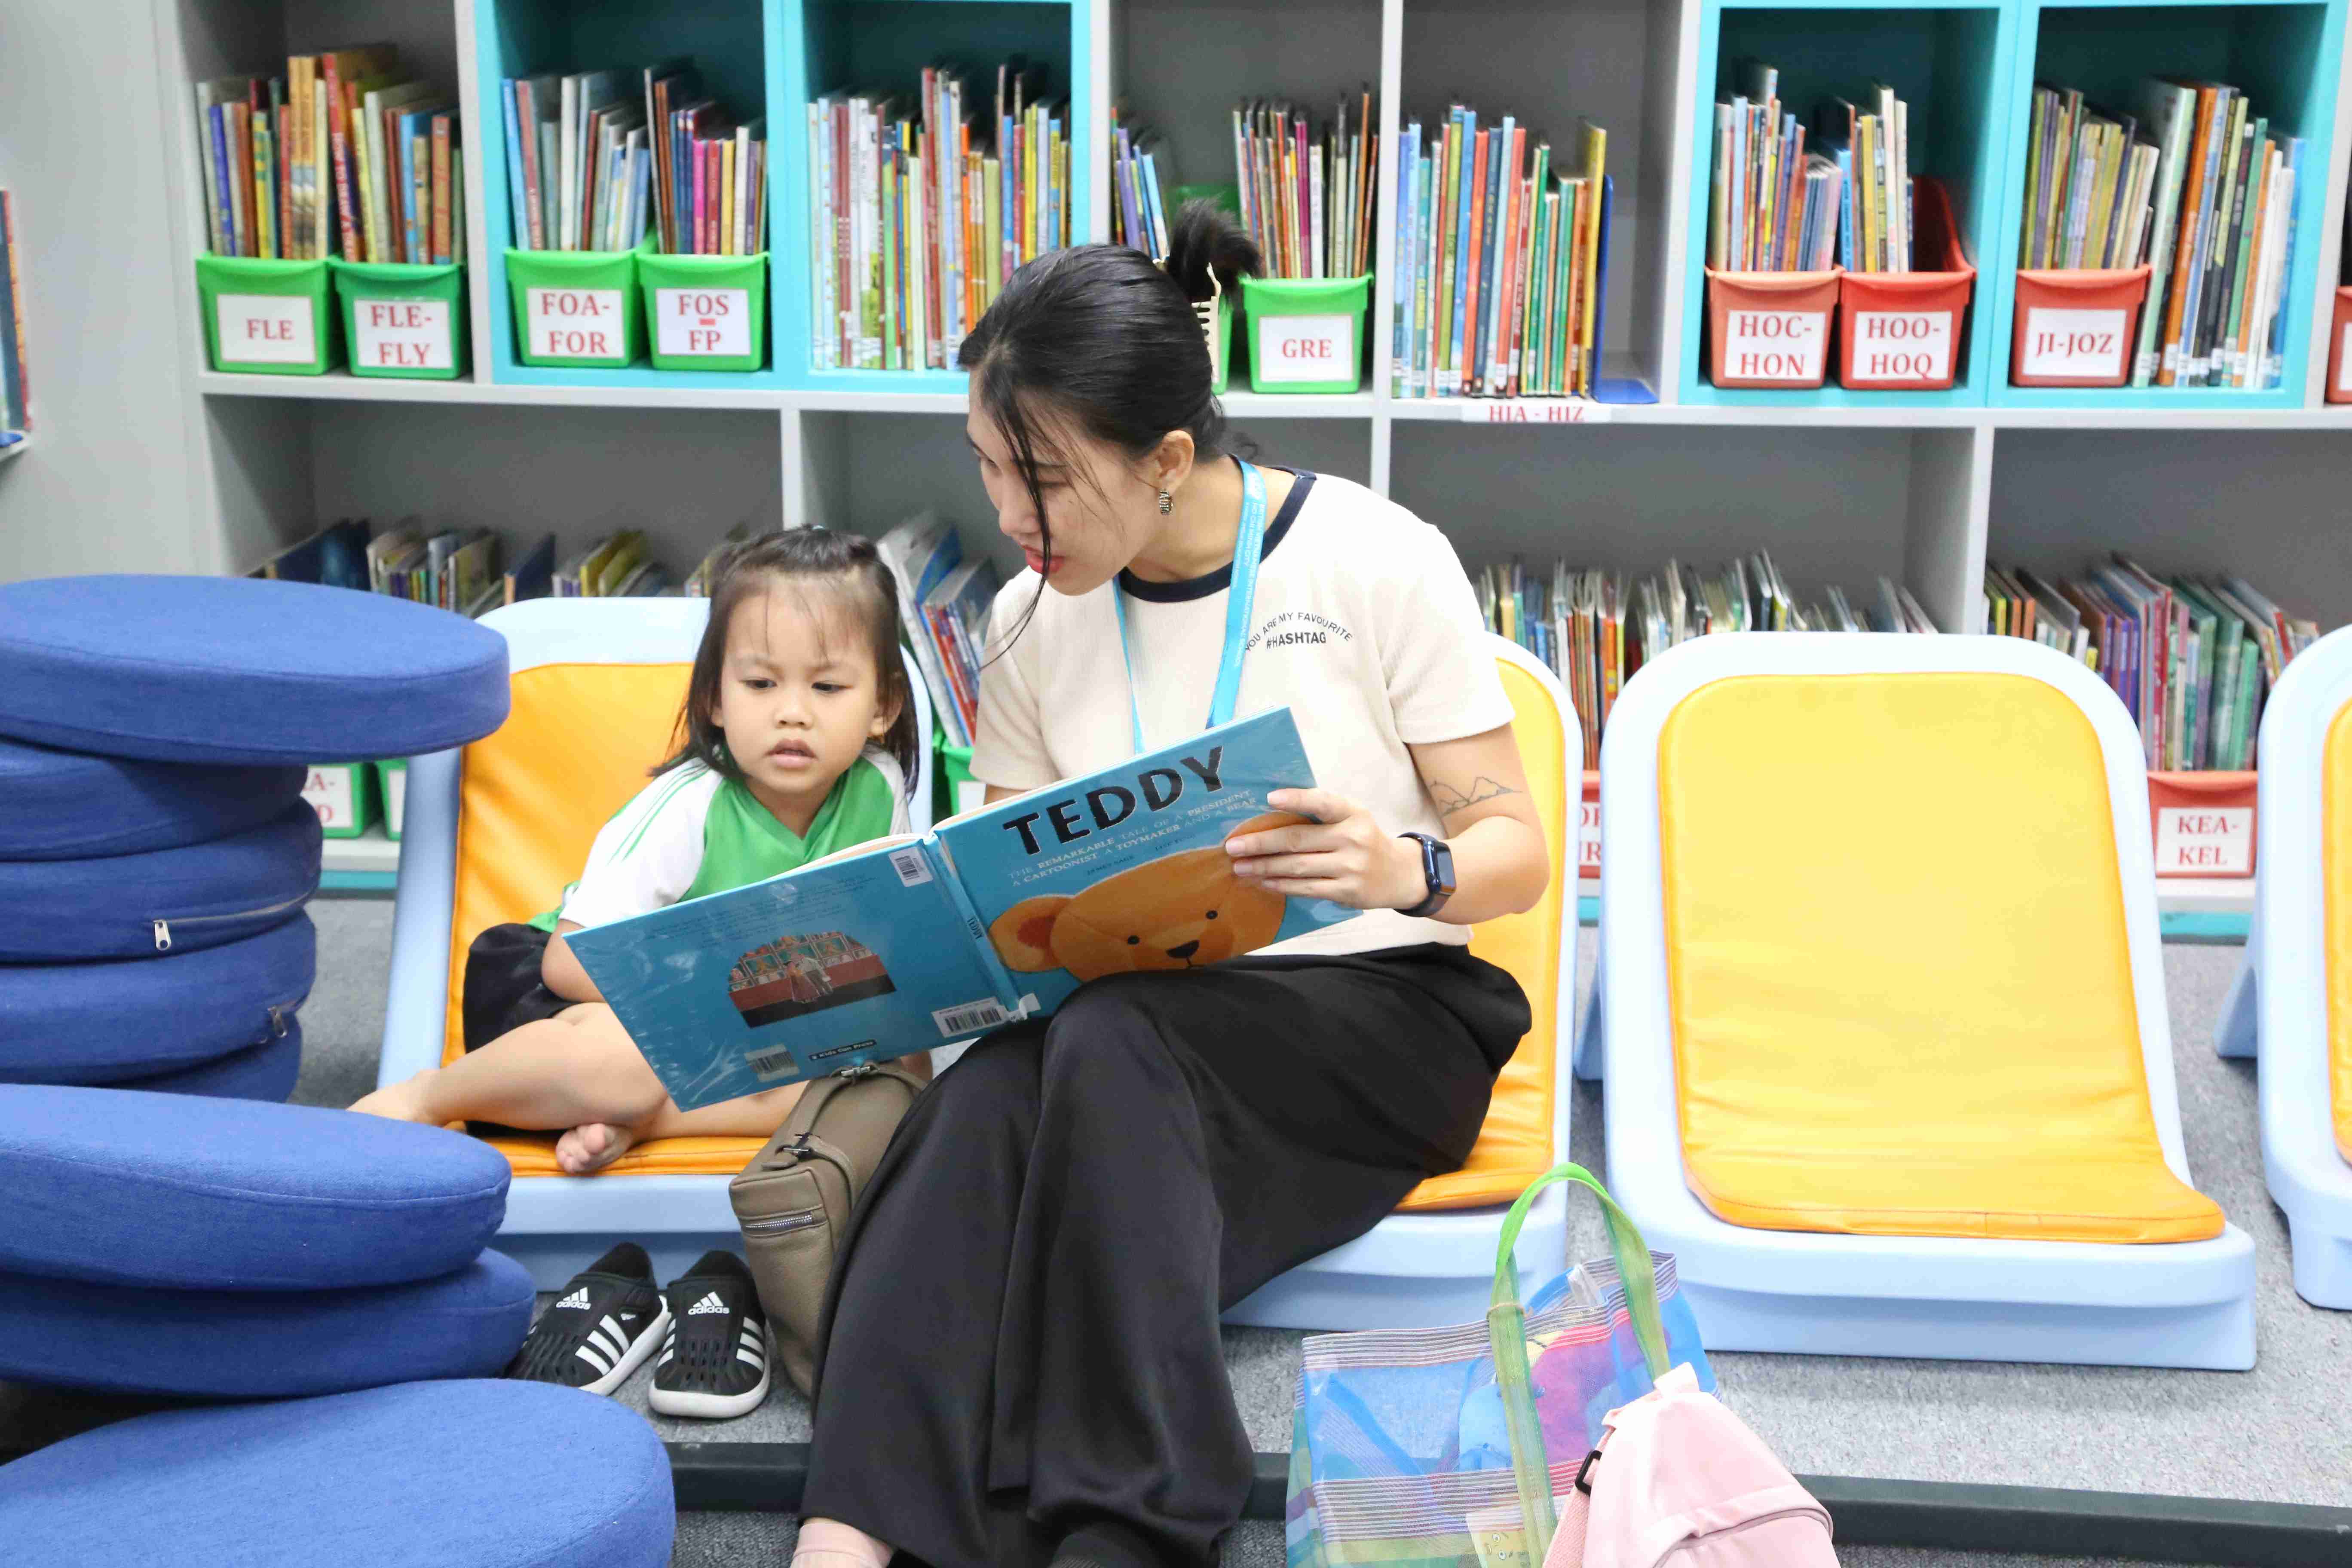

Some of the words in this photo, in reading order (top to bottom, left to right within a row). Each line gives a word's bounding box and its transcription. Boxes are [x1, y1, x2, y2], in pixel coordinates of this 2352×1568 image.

[543, 294, 610, 316] FOA-
[679, 296, 729, 315] FOS
[371, 306, 432, 327] FLE-
[1740, 315, 1811, 337] HOC-
[248, 320, 294, 340] FLE
[1868, 317, 1941, 340] HOO-
[550, 331, 606, 354] FOR
[689, 330, 720, 351] FP
[1282, 340, 1331, 358] GRE
[2037, 332, 2111, 358] JI-JOZ
[380, 344, 430, 365] FLY
[1741, 353, 1805, 376] HON
[1871, 354, 1932, 379] HOQ
[1490, 406, 1527, 421] HIA
[1548, 406, 1584, 420] HIZ
[1245, 635, 1261, 652] YOU
[1263, 619, 1277, 634] ARE
[1278, 612, 1293, 623] MY
[1298, 612, 1353, 641] FAVOURITE
[1266, 632, 1326, 649] #HASHTAG
[1002, 745, 1224, 855] TEDDY
[1104, 848, 1112, 856] A
[1117, 824, 1181, 851] TOYMAKER
[1184, 813, 1210, 827] AND
[1228, 798, 1257, 812] BEAR
[2178, 815, 2239, 833] KEA-
[1009, 867, 1032, 879] THE
[1038, 837, 1115, 870] REMARKABLE
[1121, 827, 1148, 840] TALE
[1154, 818, 1170, 829] OF
[1174, 813, 1182, 821] A
[2179, 846, 2227, 865] KEL
[966, 917, 983, 940] TEDDY
[556, 1300, 591, 1310] adidas
[688, 1305, 729, 1315] adidas
